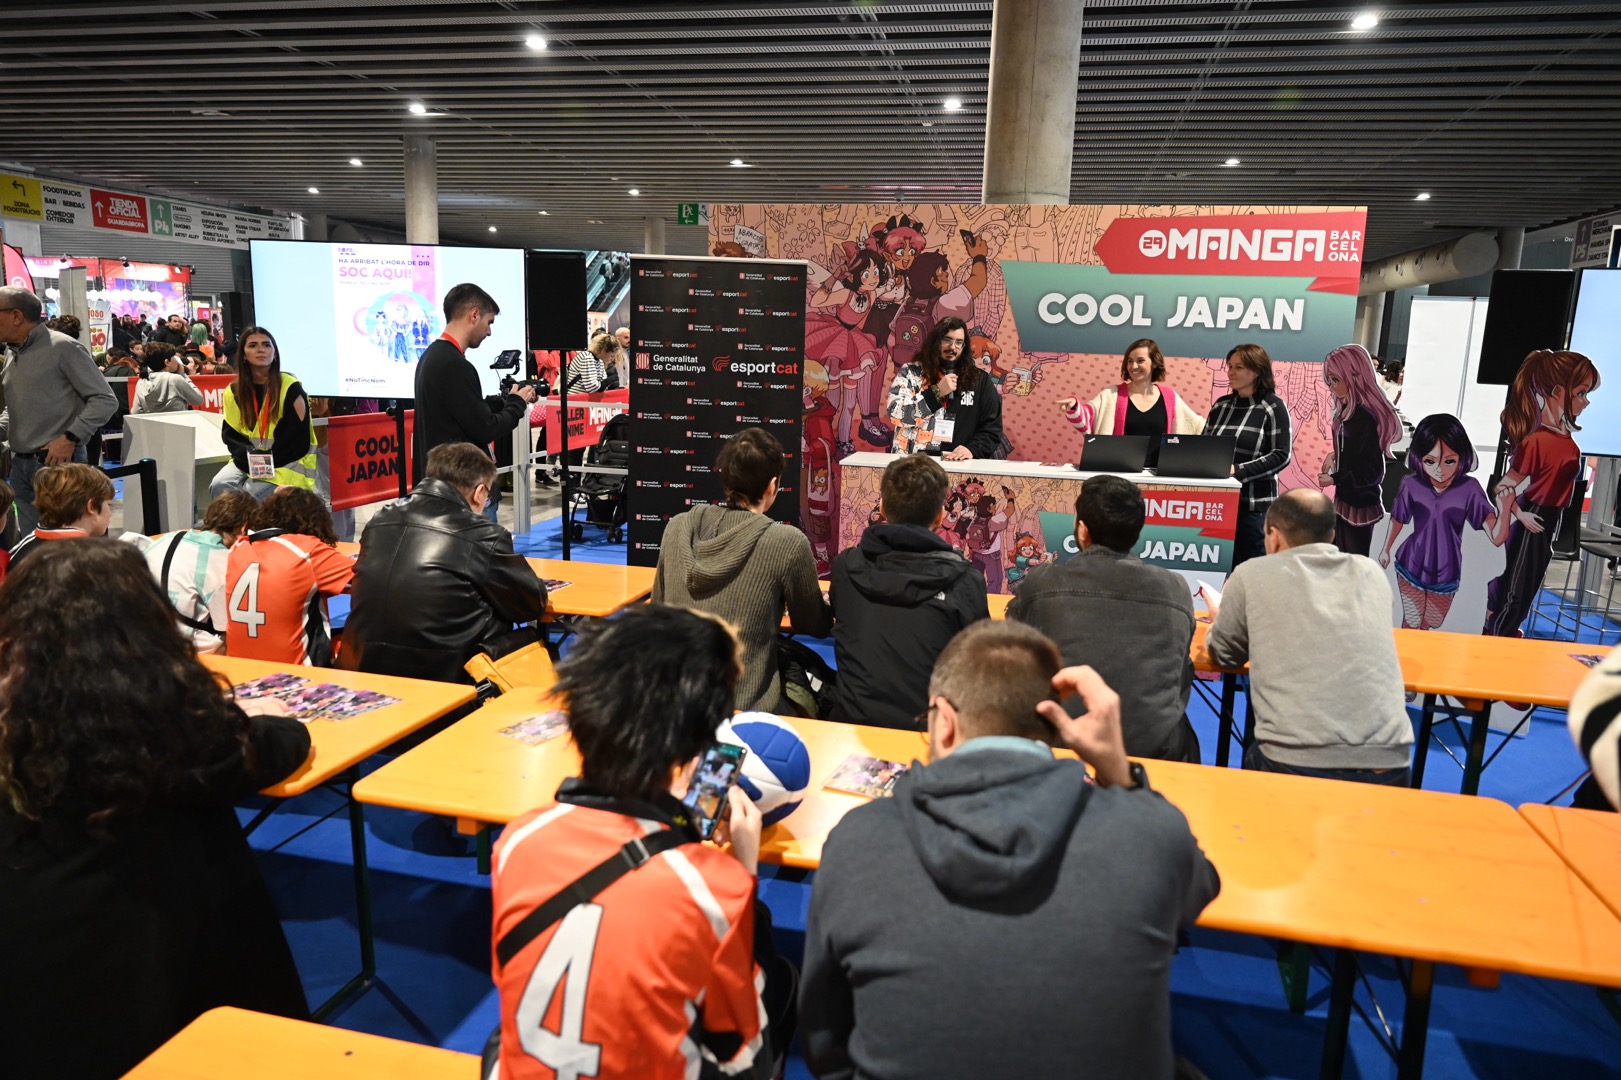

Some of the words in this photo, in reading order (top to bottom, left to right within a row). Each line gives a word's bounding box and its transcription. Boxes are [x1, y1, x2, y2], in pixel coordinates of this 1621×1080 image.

[43, 185, 82, 198] FOODTRUCKS
[62, 200, 85, 208] BEBIDAS
[110, 198, 139, 209] TIENDA
[3, 206, 41, 216] FOODTRUCKS
[46, 210, 74, 218] COMEDOR
[109, 207, 141, 218] OFICIAL
[46, 216, 74, 224] EXTERIOR
[107, 218, 145, 228] GUARDARROPA
[154, 220, 169, 234] P4
[1330, 230, 1361, 240] BAR
[1144, 236, 1162, 249] 29
[1167, 228, 1326, 262] MANGA
[1329, 241, 1358, 251] CEL
[1328, 251, 1360, 263] ONA
[339, 267, 368, 277] SOC
[1038, 292, 1152, 326] COOL
[1167, 296, 1305, 331] JAPAN
[653, 354, 698, 363] Generalitat
[665, 364, 706, 373] Catalunya
[730, 362, 798, 375] esportcat
[567, 423, 584, 437] NIME
[355, 435, 399, 458] COOL
[346, 456, 400, 483] JAPAN
[1140, 540, 1220, 563] JAPAN
[229, 562, 265, 637] 4
[516, 902, 603, 1080] 4
